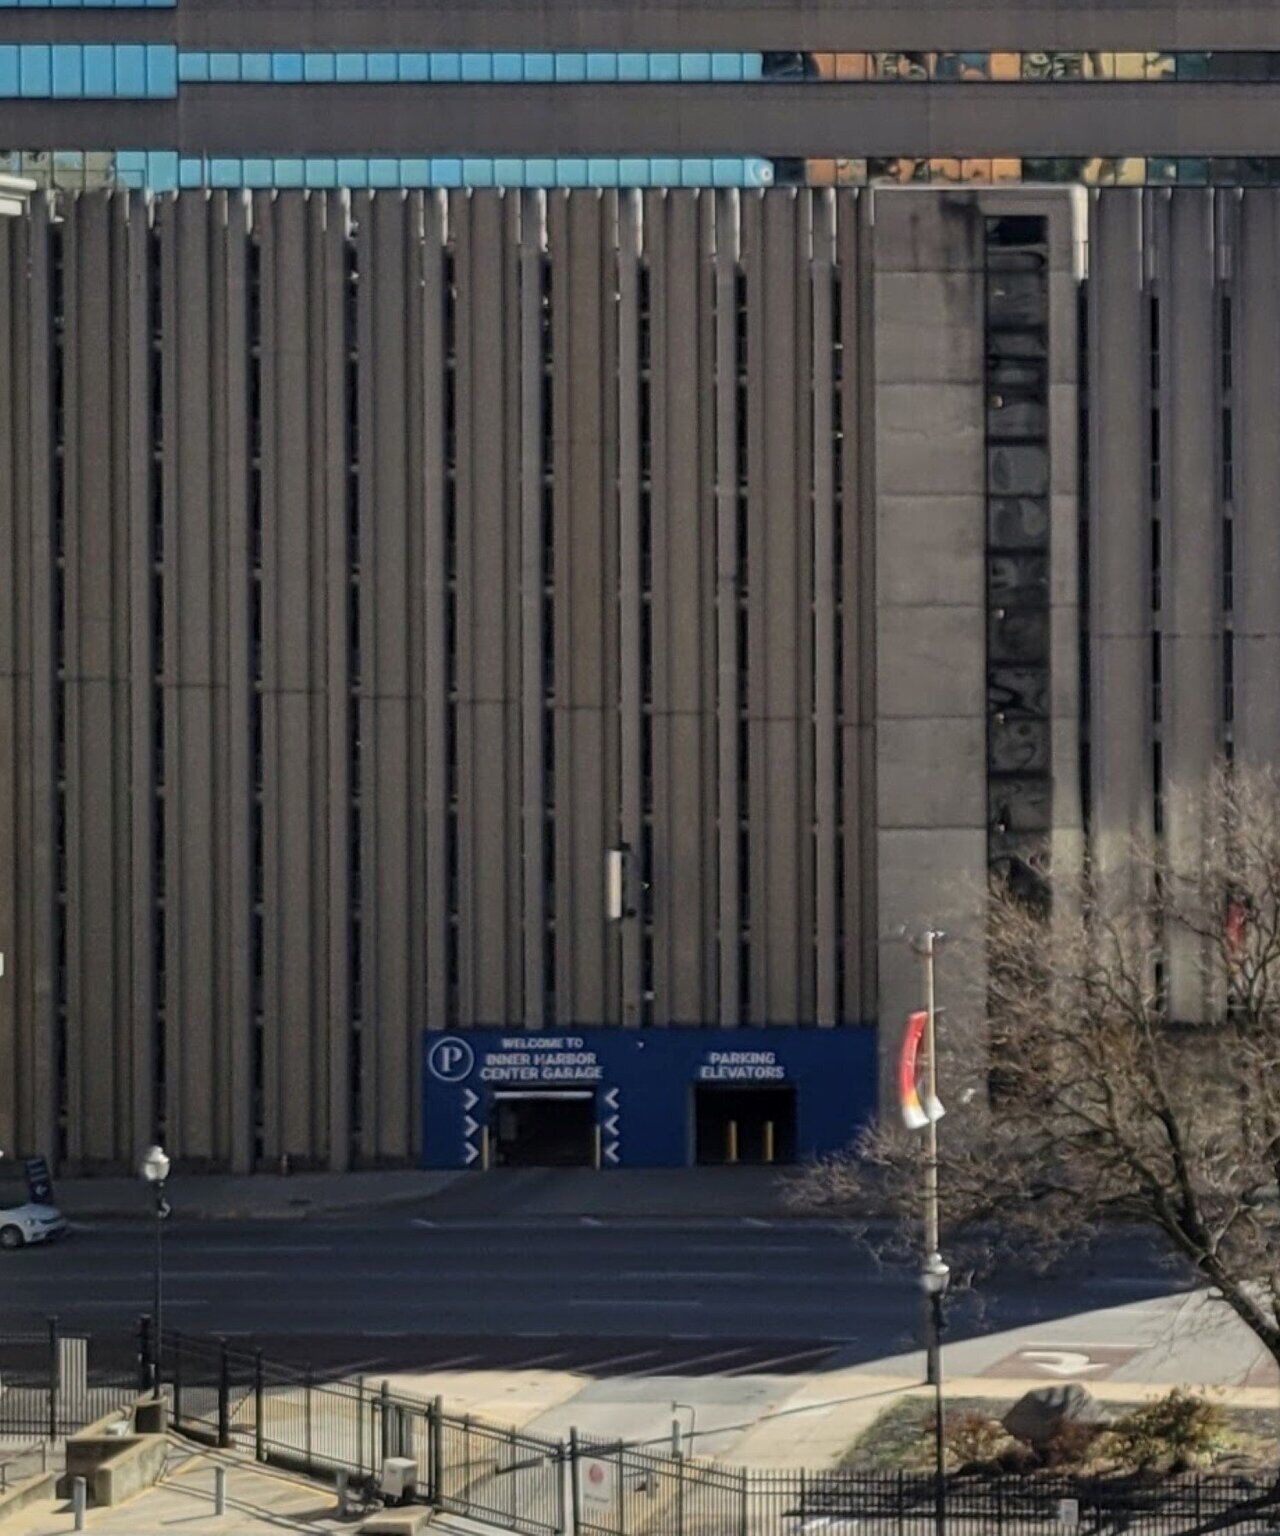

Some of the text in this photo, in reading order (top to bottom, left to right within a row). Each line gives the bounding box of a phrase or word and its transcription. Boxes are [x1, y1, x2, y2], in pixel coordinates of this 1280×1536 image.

[502, 1037, 585, 1048] WELCOME TO
[441, 1046, 462, 1071] P
[486, 1053, 597, 1065] INNER HARBOR
[710, 1052, 776, 1064] PARKING
[480, 1066, 604, 1080] CENTER GARAGE
[701, 1066, 784, 1079] ELEVATORS
